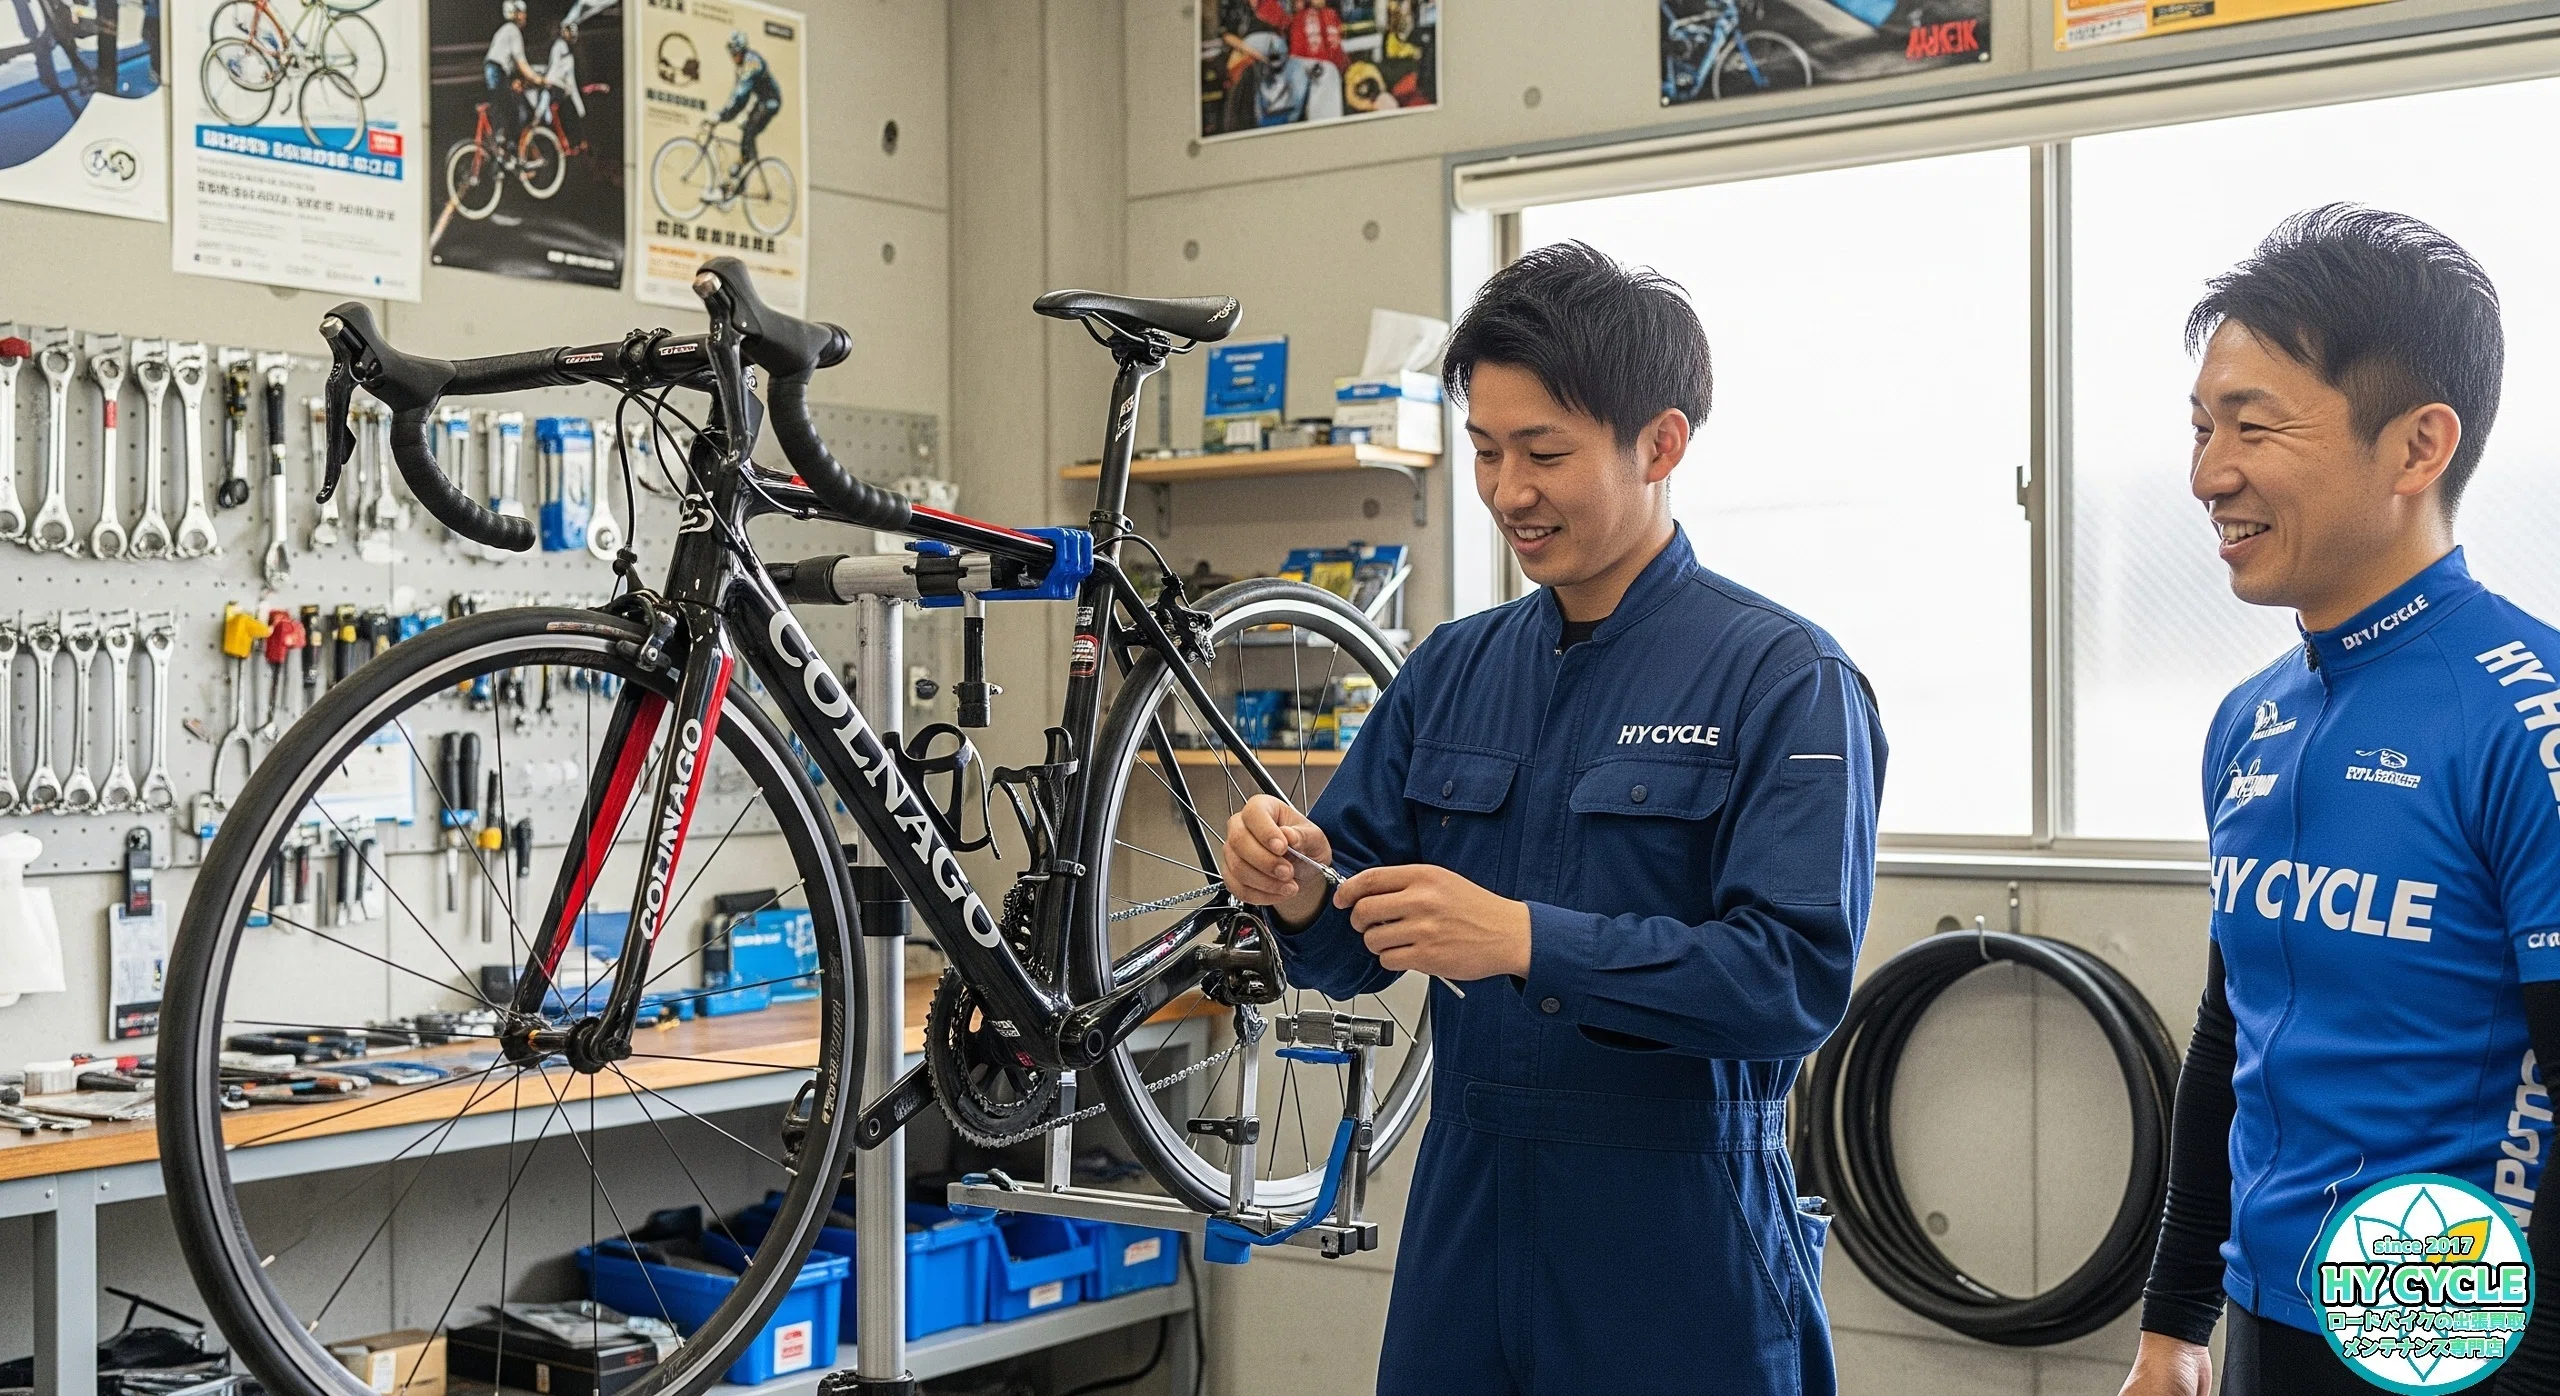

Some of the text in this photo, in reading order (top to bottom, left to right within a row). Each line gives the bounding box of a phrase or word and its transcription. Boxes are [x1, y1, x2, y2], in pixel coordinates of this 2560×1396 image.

[2475, 640, 2556, 687] HY
[769, 610, 1001, 949] COLNAGO
[2211, 855, 2438, 943] HY CYCLE
